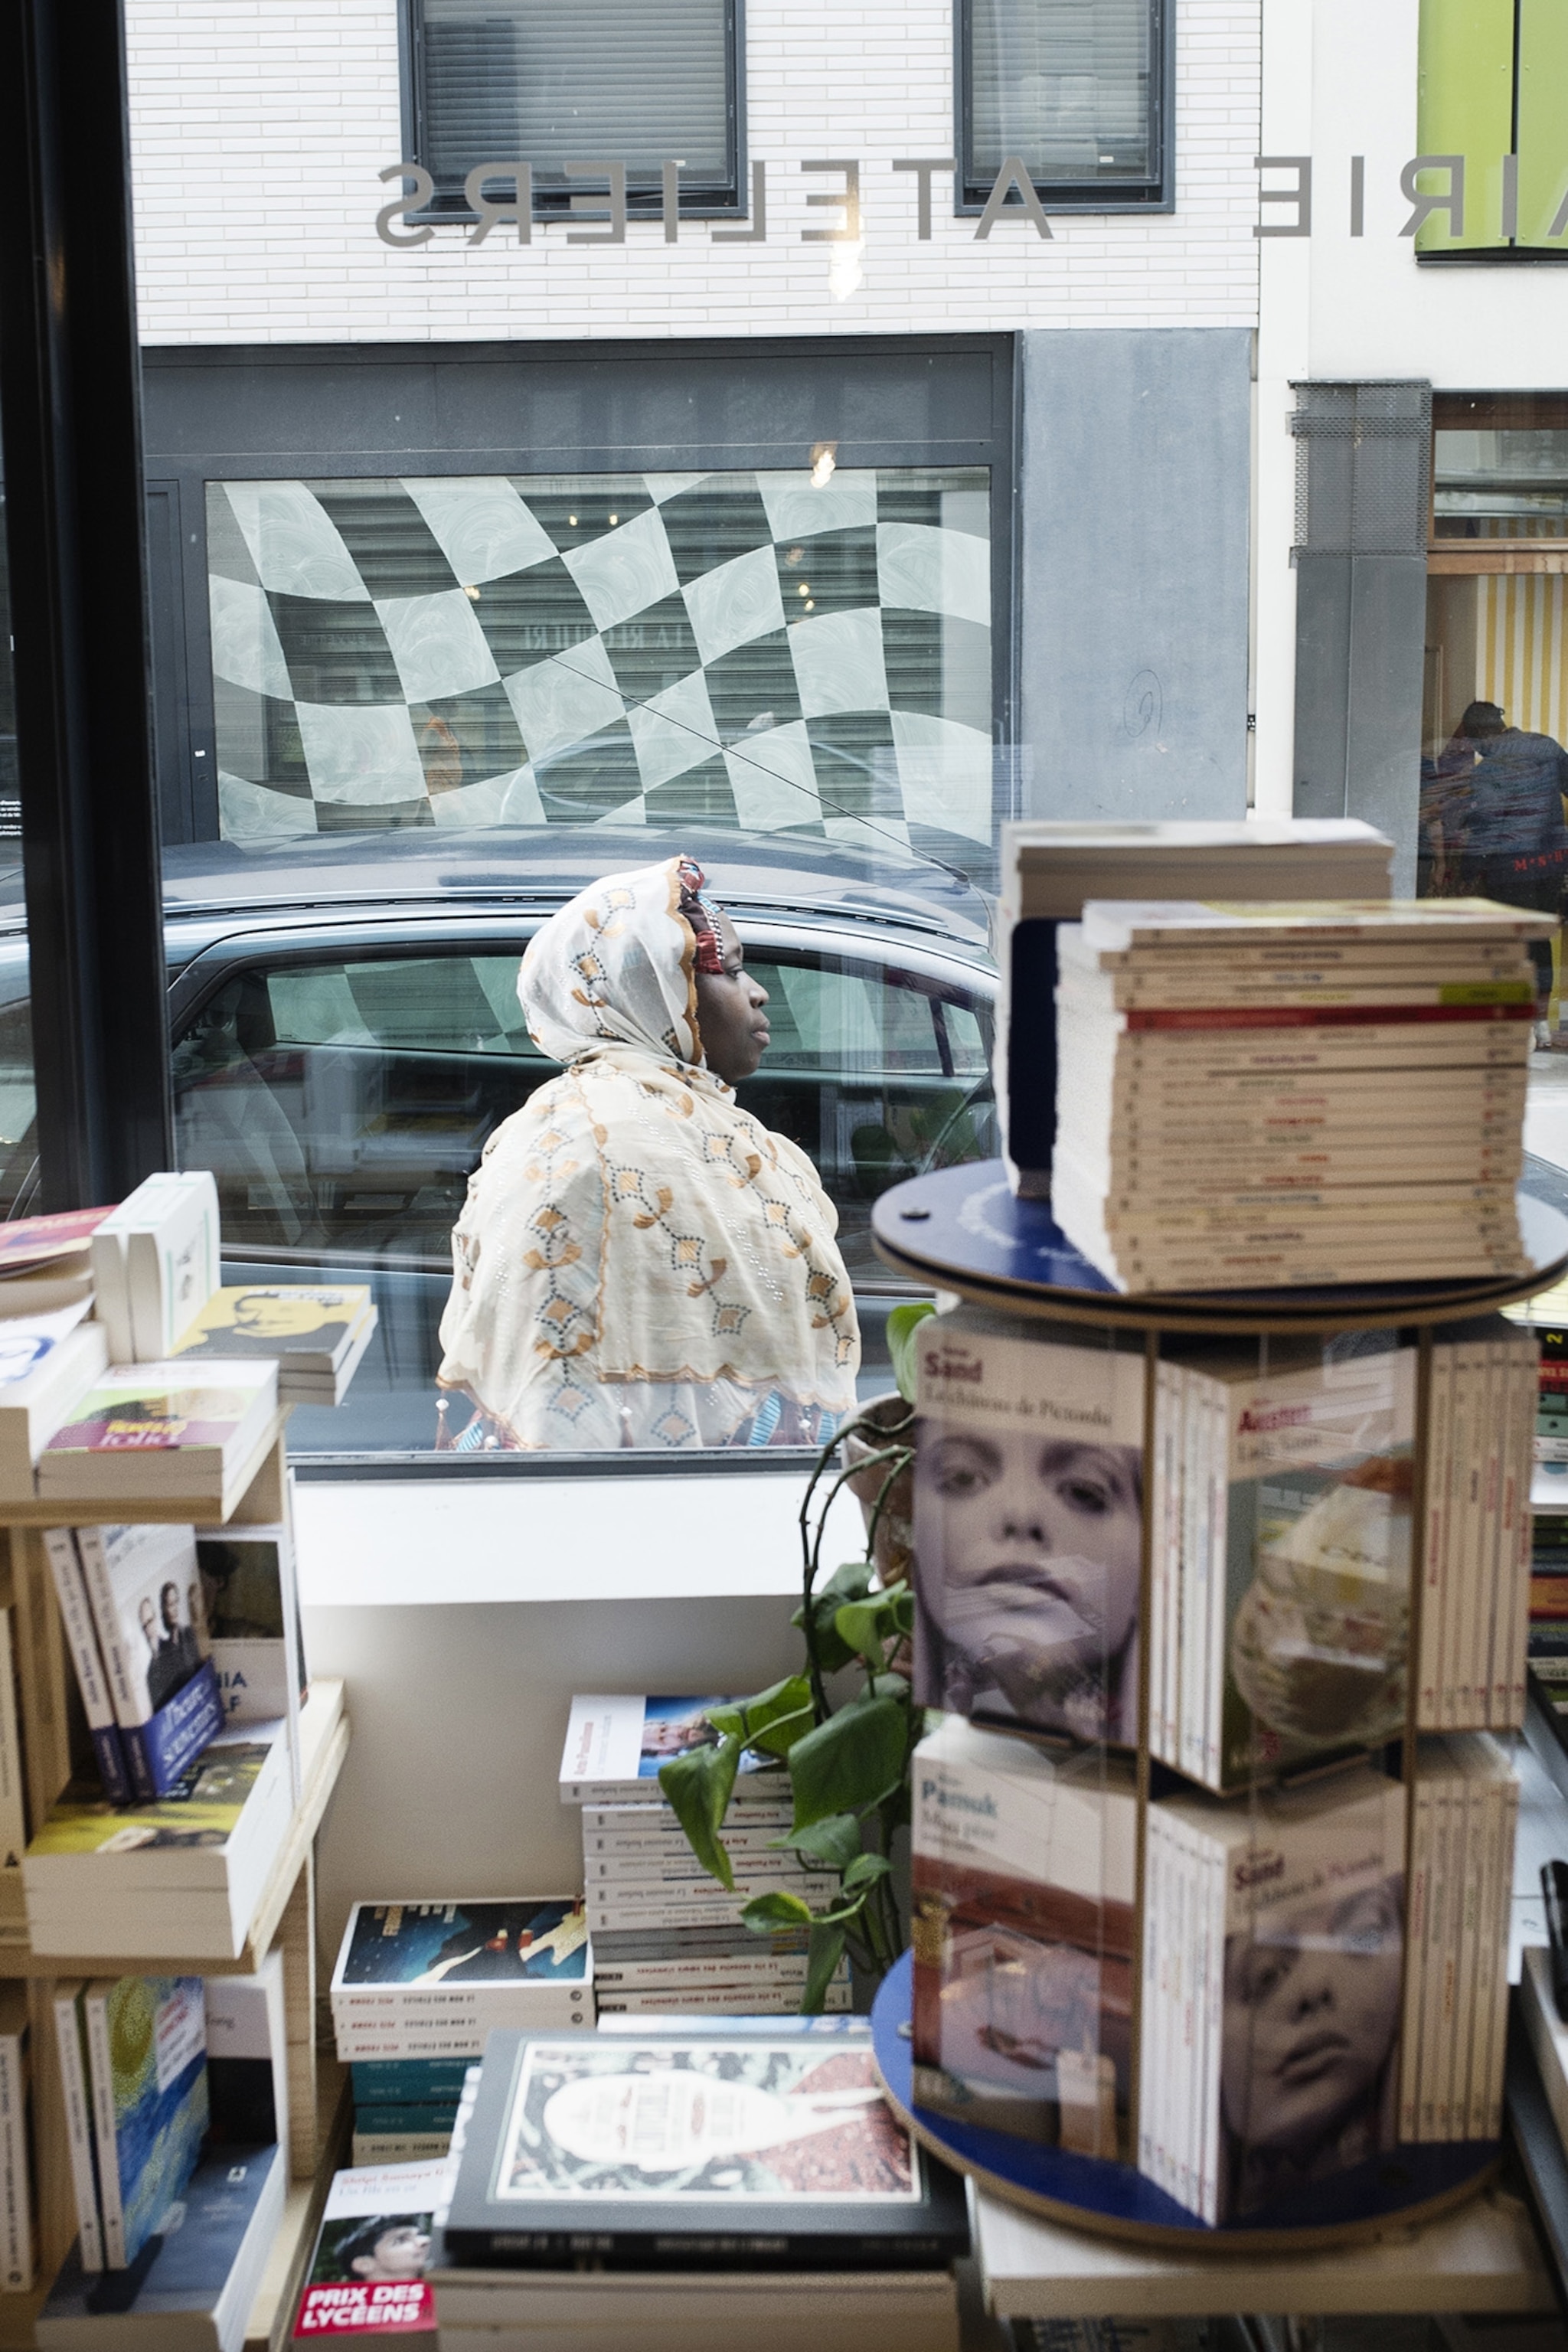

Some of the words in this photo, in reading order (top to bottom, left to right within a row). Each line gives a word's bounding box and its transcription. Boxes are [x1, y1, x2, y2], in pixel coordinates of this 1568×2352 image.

[925, 1351, 983, 1384] Sand
[920, 1780, 998, 1820] Pamuk
[307, 2286, 368, 2308] PRIX
[372, 2284, 425, 2305] DES
[302, 2301, 420, 2329] LYCÉENS
